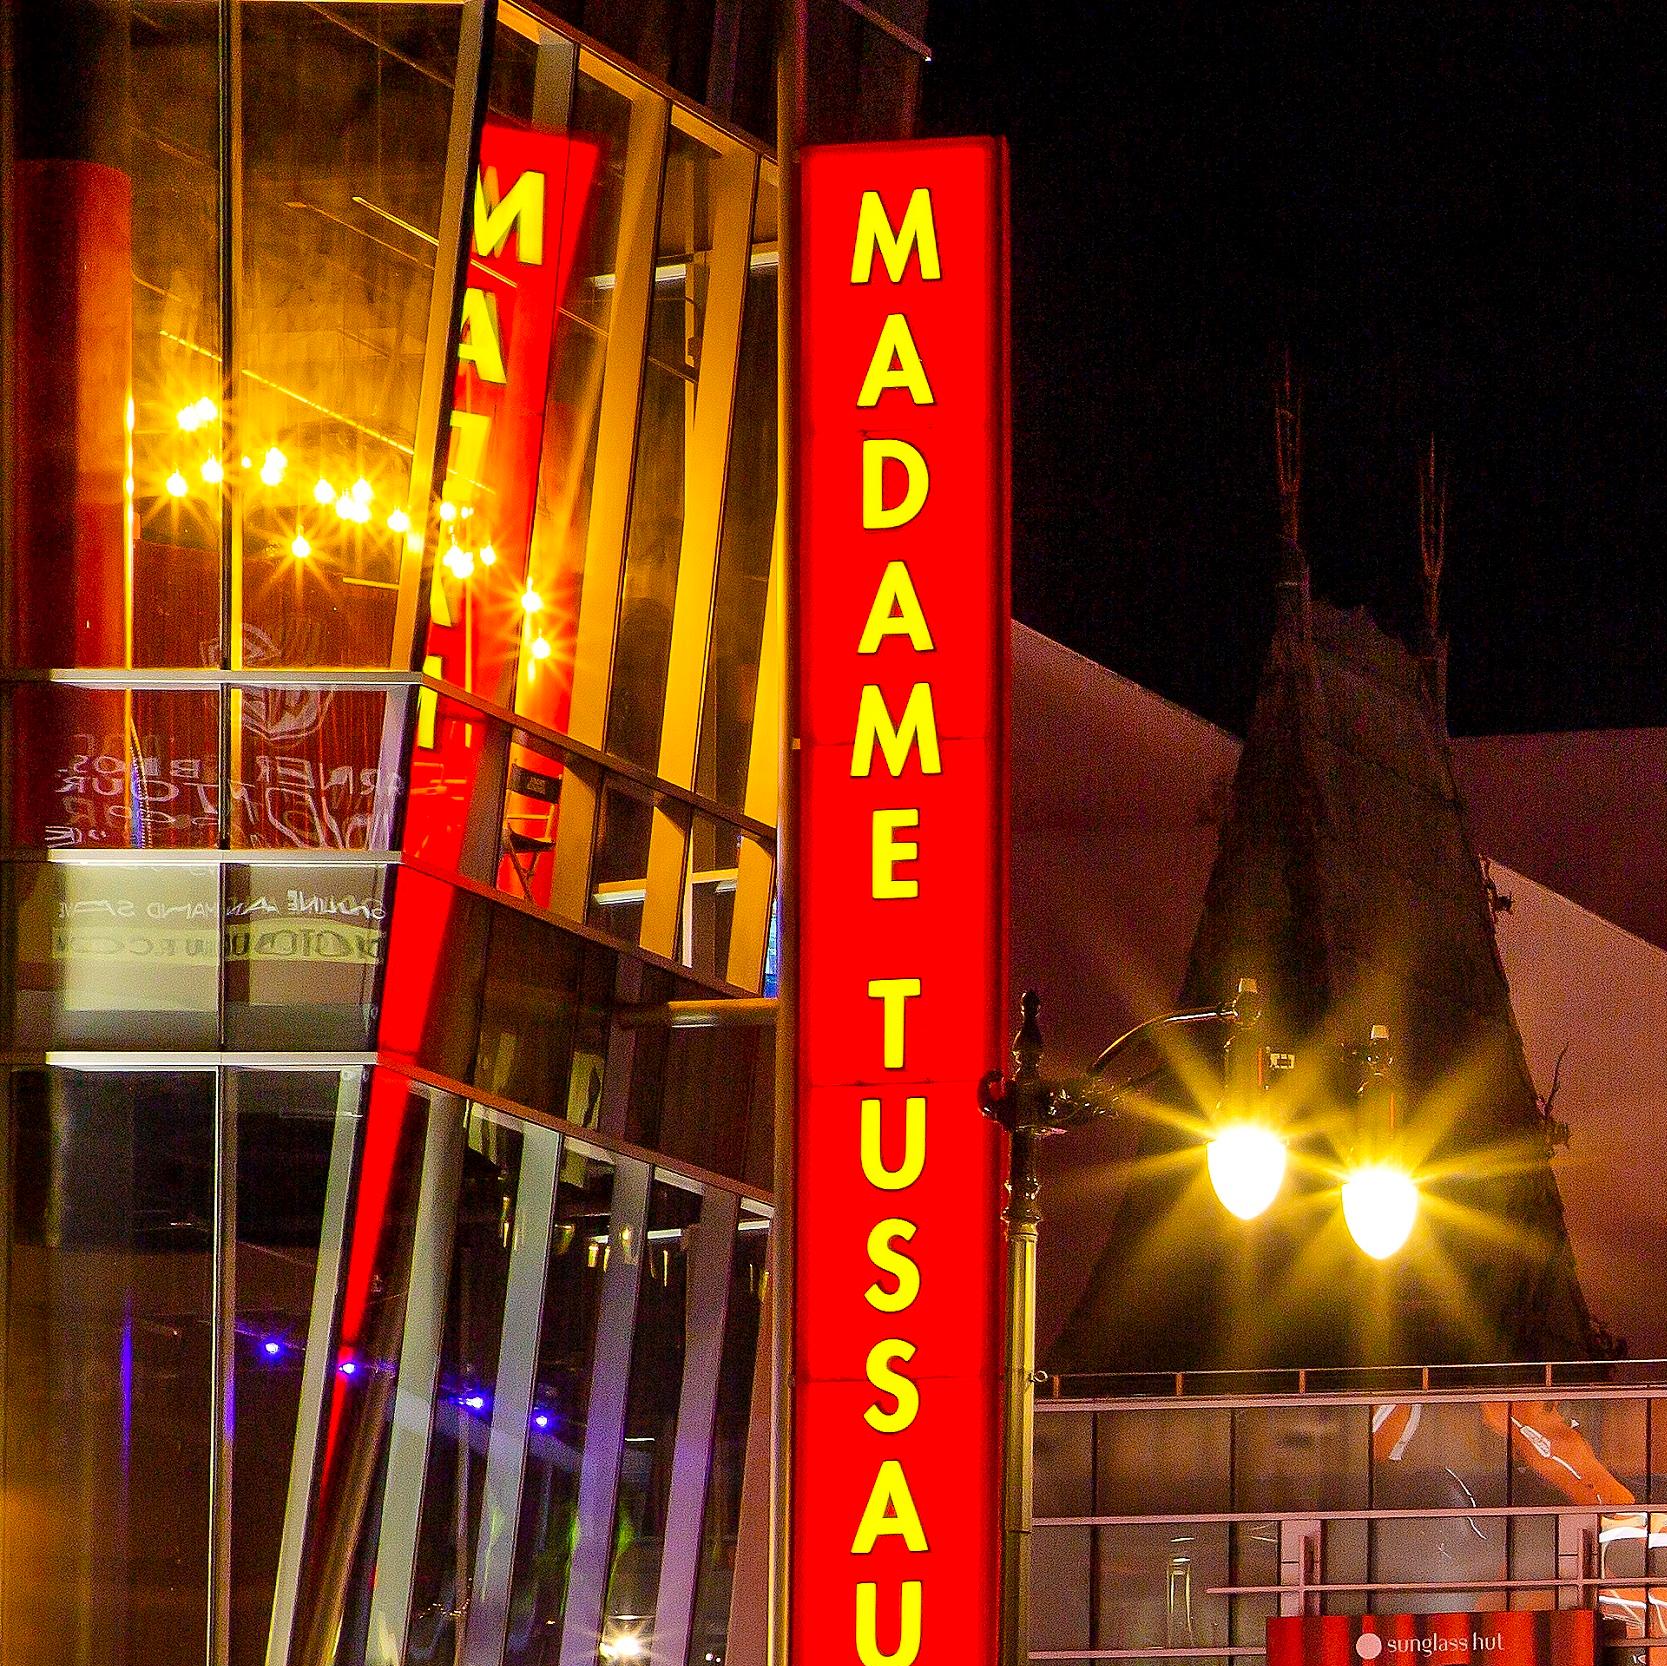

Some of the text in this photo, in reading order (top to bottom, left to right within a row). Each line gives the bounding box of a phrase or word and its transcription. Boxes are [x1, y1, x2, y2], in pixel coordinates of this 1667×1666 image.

[848, 187, 944, 902] MADAME
[1387, 1631, 1504, 1657] sunglass hut
